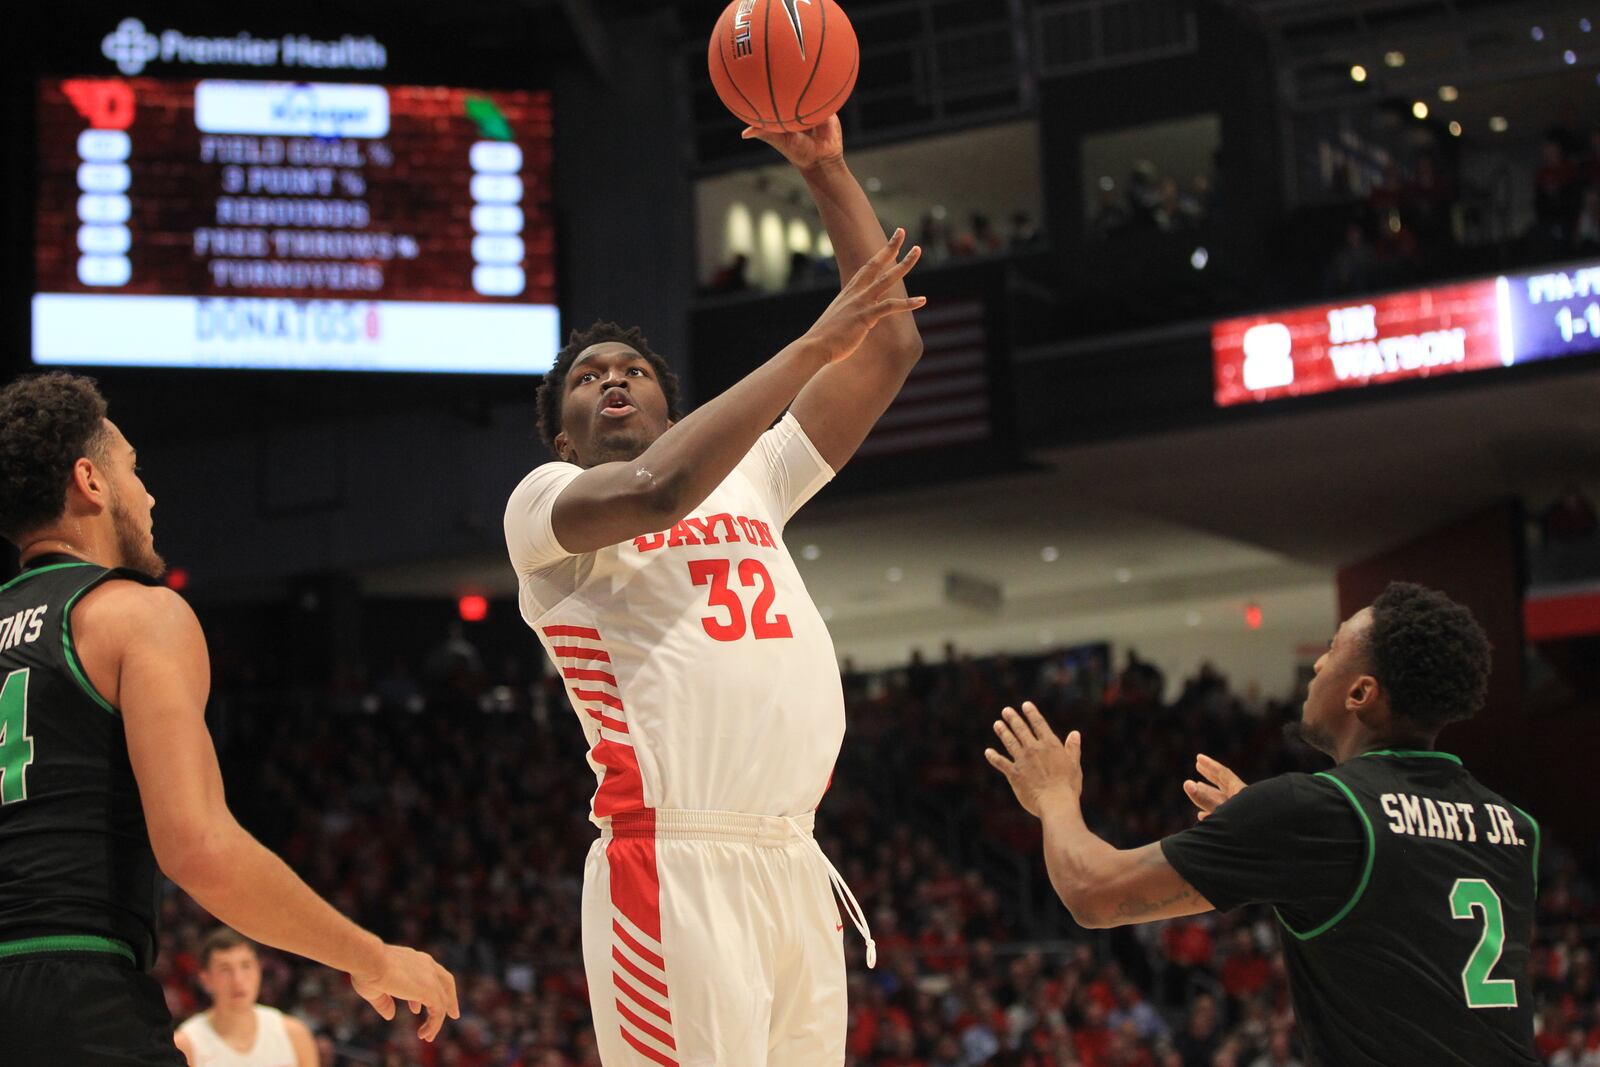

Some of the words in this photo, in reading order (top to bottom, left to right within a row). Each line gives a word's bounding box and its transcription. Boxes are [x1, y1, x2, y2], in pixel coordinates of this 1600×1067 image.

[160, 29, 279, 66] Premier
[282, 34, 388, 70] Health
[200, 136, 285, 164] FIELD
[247, 166, 336, 195] POINT
[216, 196, 370, 229] REBOUNDS
[193, 226, 270, 256] FREE
[207, 258, 385, 291] TURNOVERS
[1328, 327, 1466, 381] WATSON
[688, 558, 794, 642] 32
[1379, 793, 1477, 843] SMART
[1483, 803, 1527, 846] JR.
[1449, 877, 1518, 1008] 2
